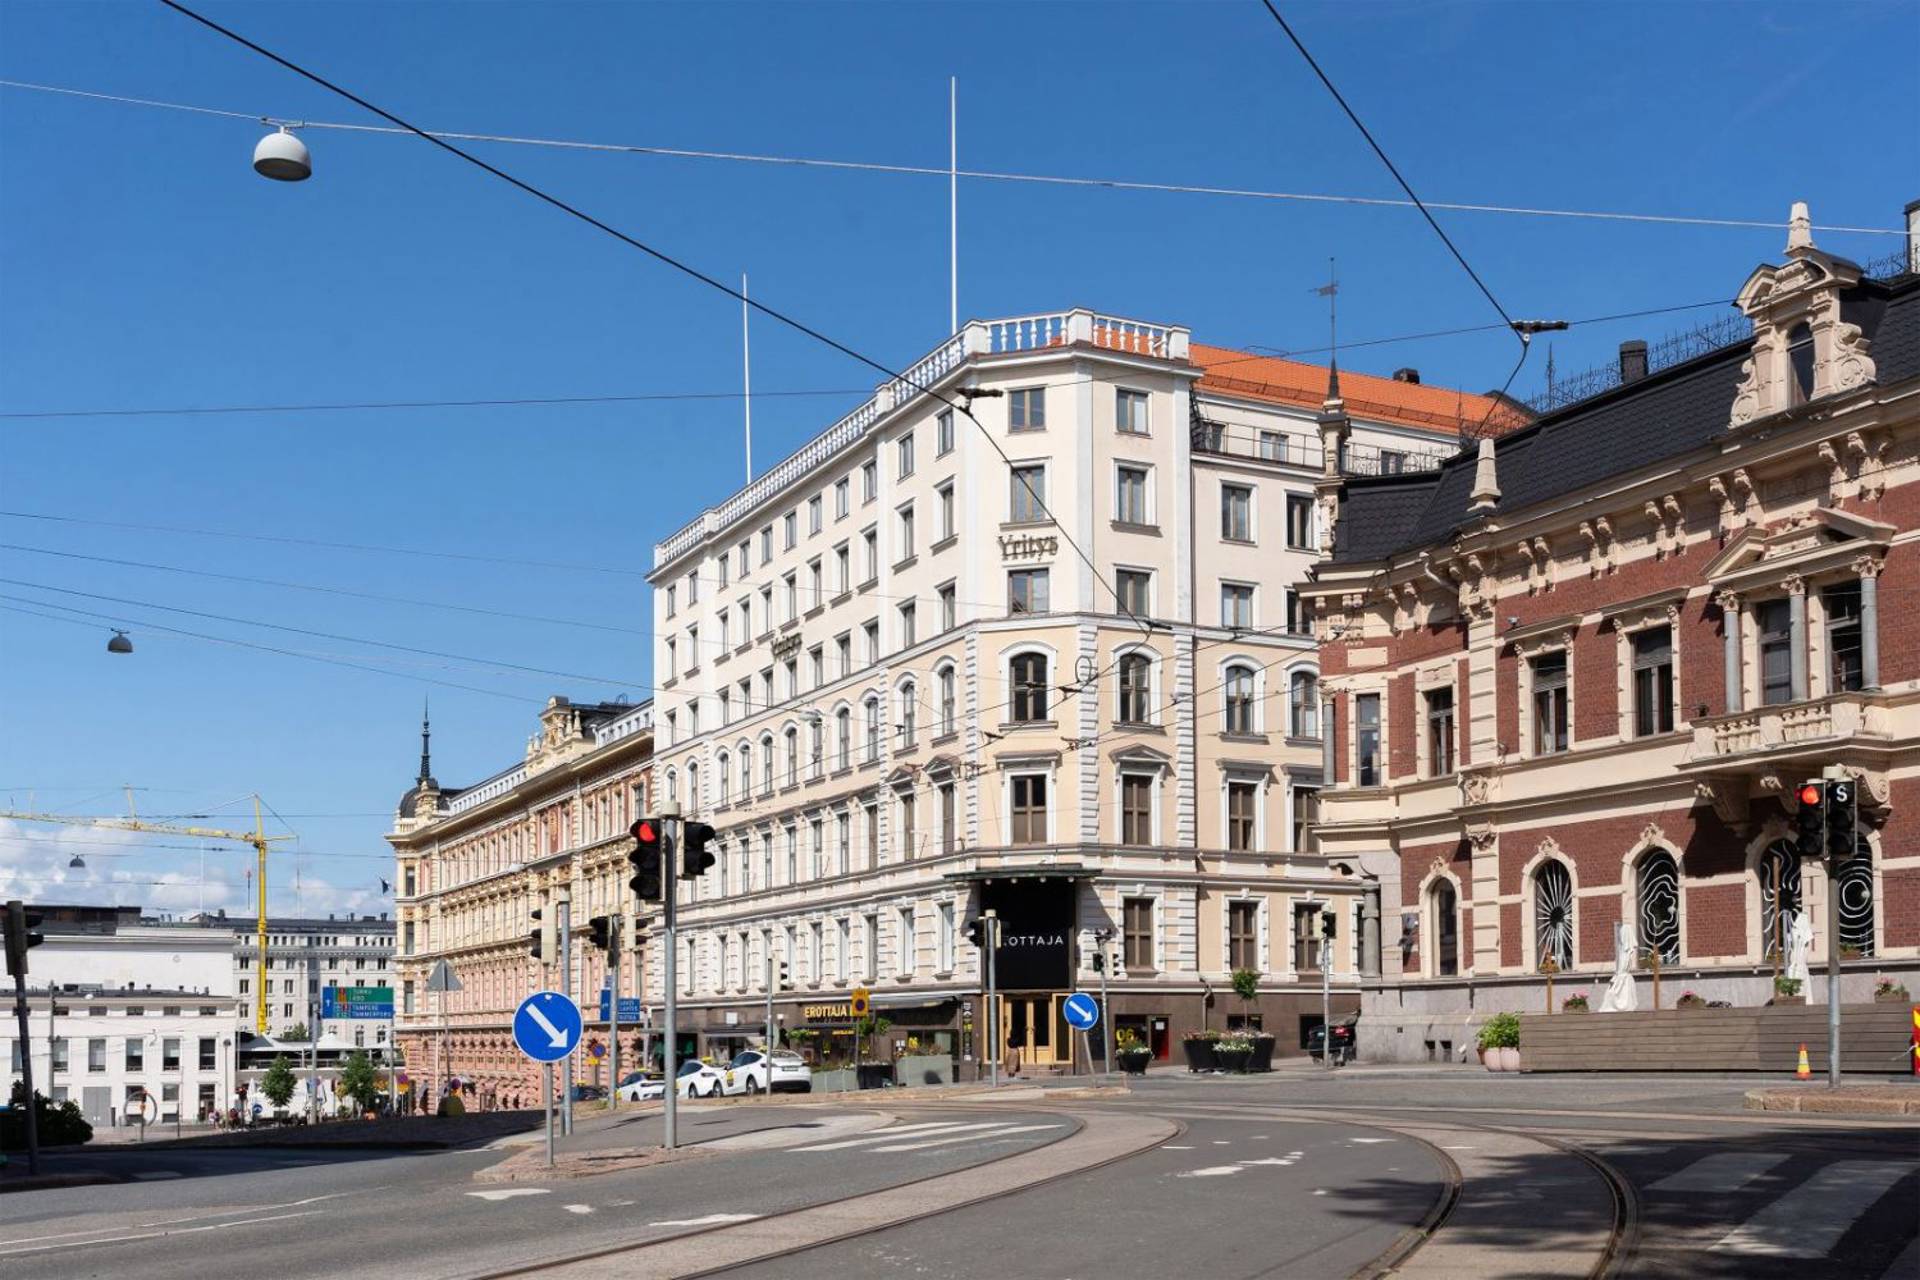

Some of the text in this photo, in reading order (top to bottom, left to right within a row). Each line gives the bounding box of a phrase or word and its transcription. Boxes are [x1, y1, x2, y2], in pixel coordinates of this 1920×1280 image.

[1836, 785, 1848, 802] S
[1003, 935, 1064, 947] OTTAJA
[804, 1005, 848, 1018] EROTTAJA
